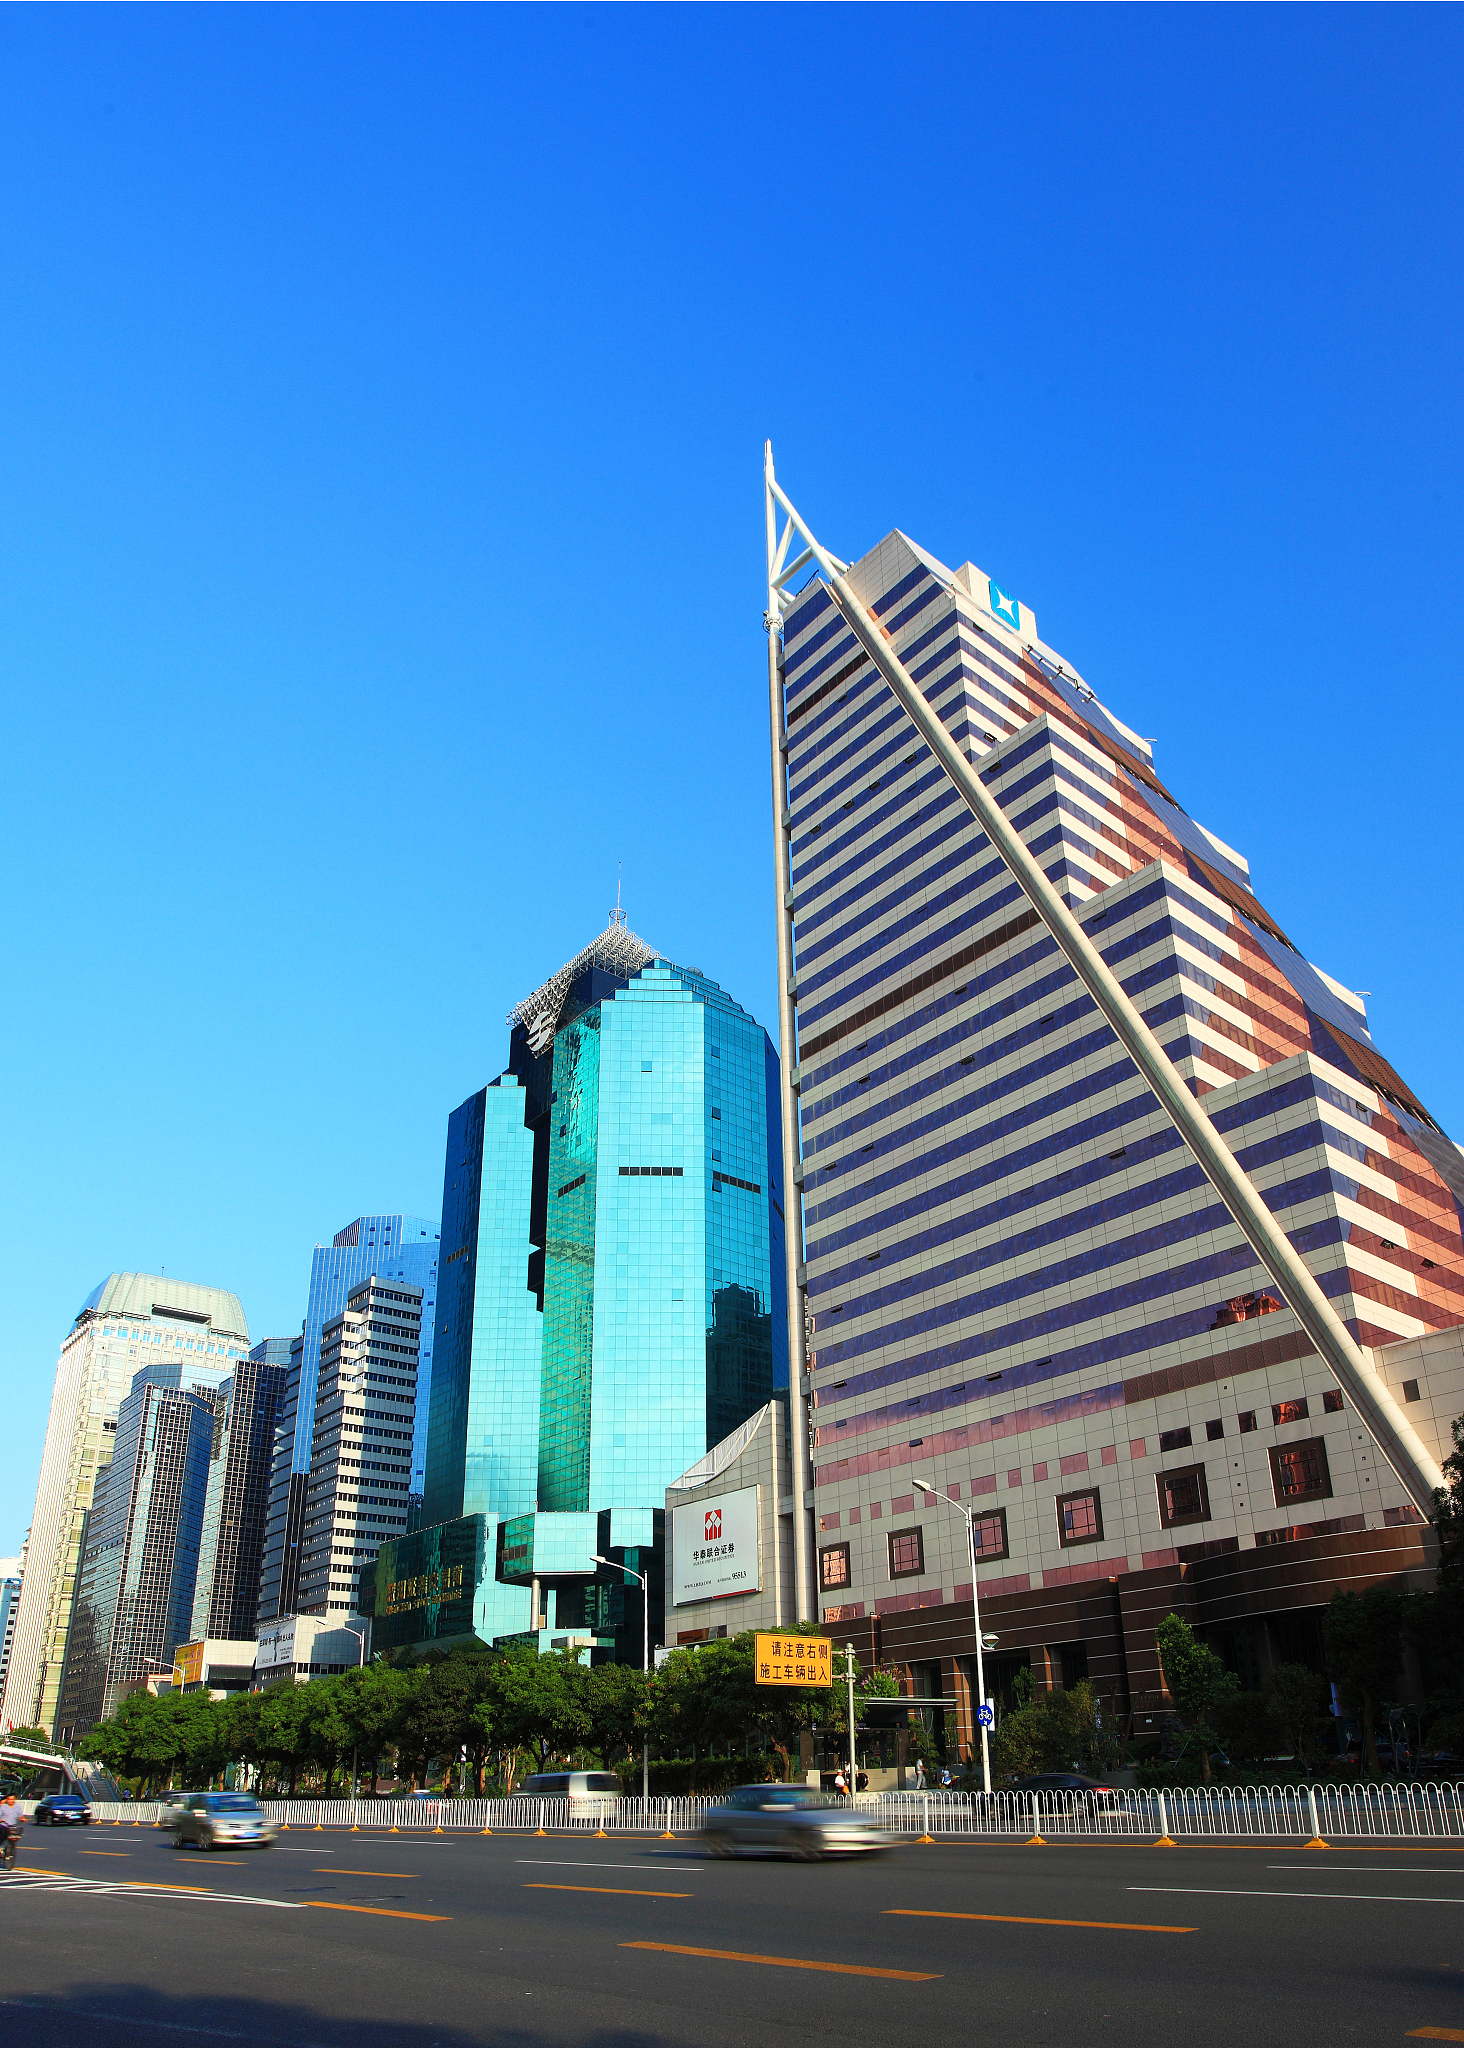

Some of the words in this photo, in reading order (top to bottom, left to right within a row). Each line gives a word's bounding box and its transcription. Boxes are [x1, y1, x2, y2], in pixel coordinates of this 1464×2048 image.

[693, 1543, 735, 1561] 华泰联合证券
[731, 1570, 747, 1580] 95513
[772, 1641, 828, 1659] 请注意右侧
[760, 1662, 828, 1681] 施工车辆出入
